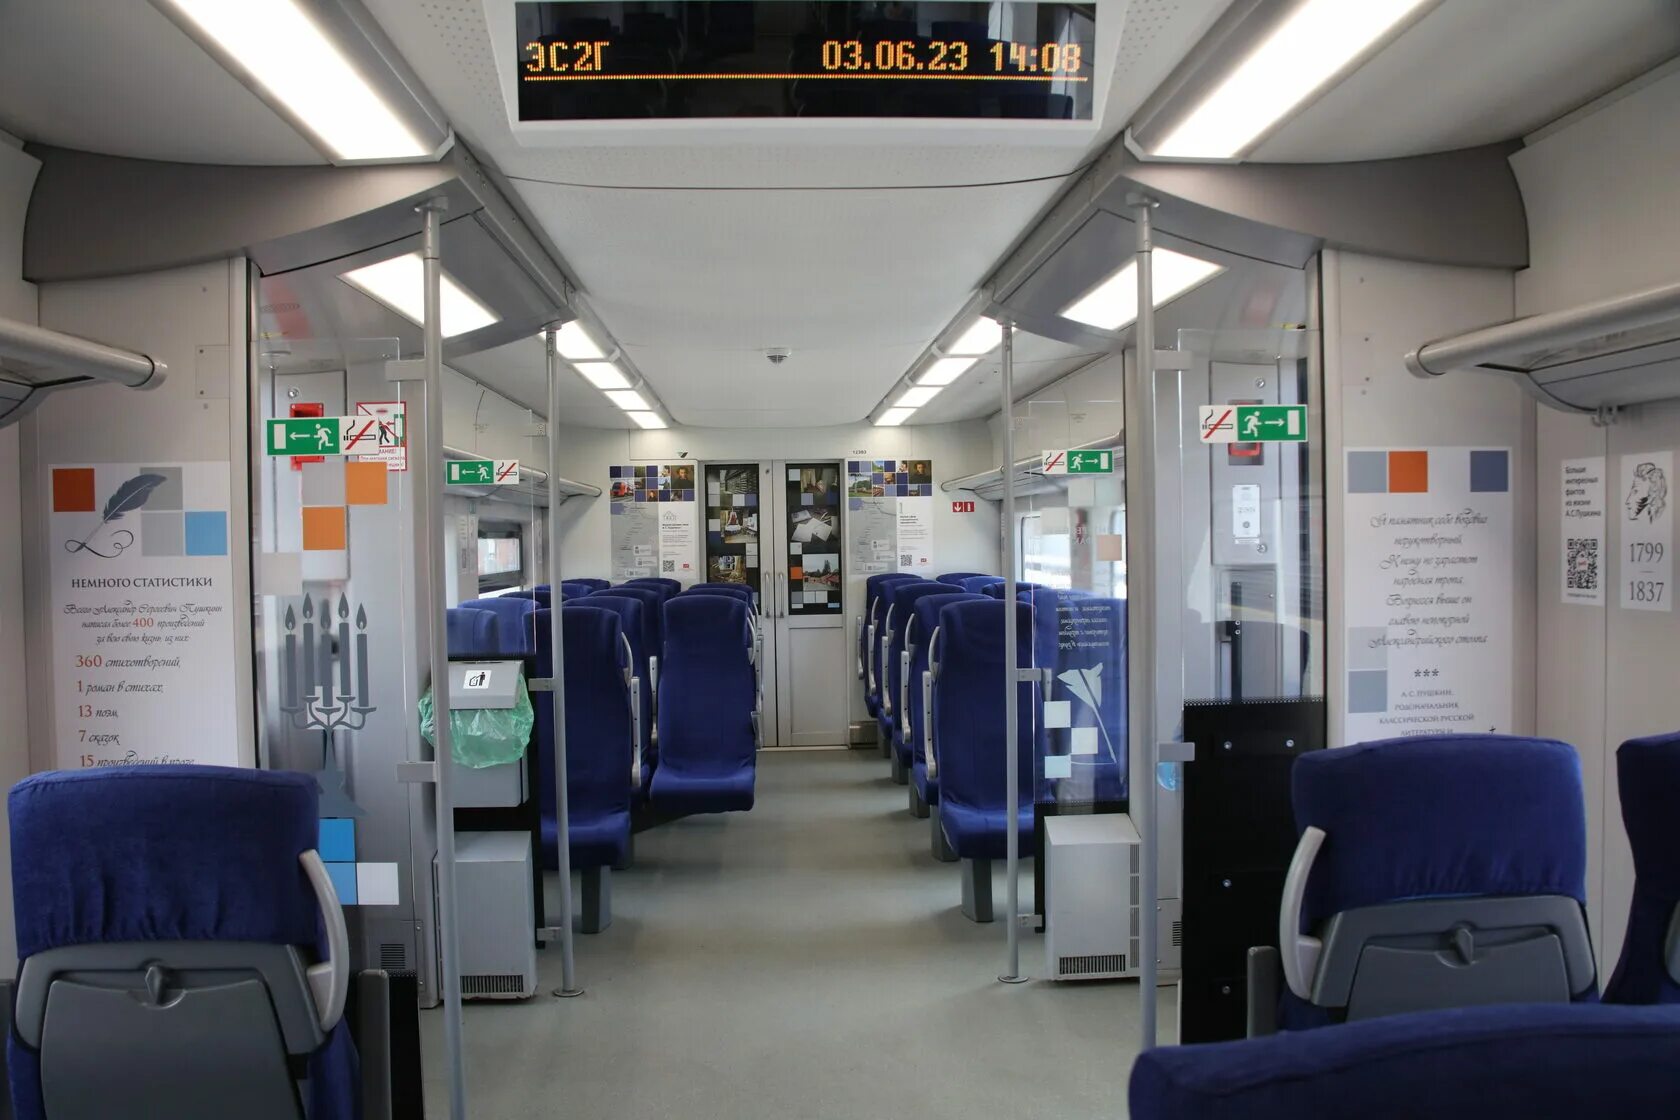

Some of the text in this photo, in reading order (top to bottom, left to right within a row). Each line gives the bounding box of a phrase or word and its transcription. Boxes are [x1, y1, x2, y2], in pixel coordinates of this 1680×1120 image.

[526, 40, 1081, 72] ЭС2Г 03.06.23 14:08
[1630, 542, 1664, 563] 1799
[72, 578, 212, 588] НЕМНОГО СТАТИСТИКИ
[1630, 581, 1664, 602] 1837
[92, 600, 136, 616] Александр
[133, 617, 154, 627] 400
[75, 655, 102, 667] 360
[78, 680, 82, 692] 1
[86, 684, 114, 696] роман
[117, 680, 125, 692] в
[79, 705, 92, 717] 13
[1380, 713, 1474, 724] КЛАССИЧЕСКОЙ РУССКОЙ
[79, 730, 86, 742] 7
[81, 756, 94, 767] 15
